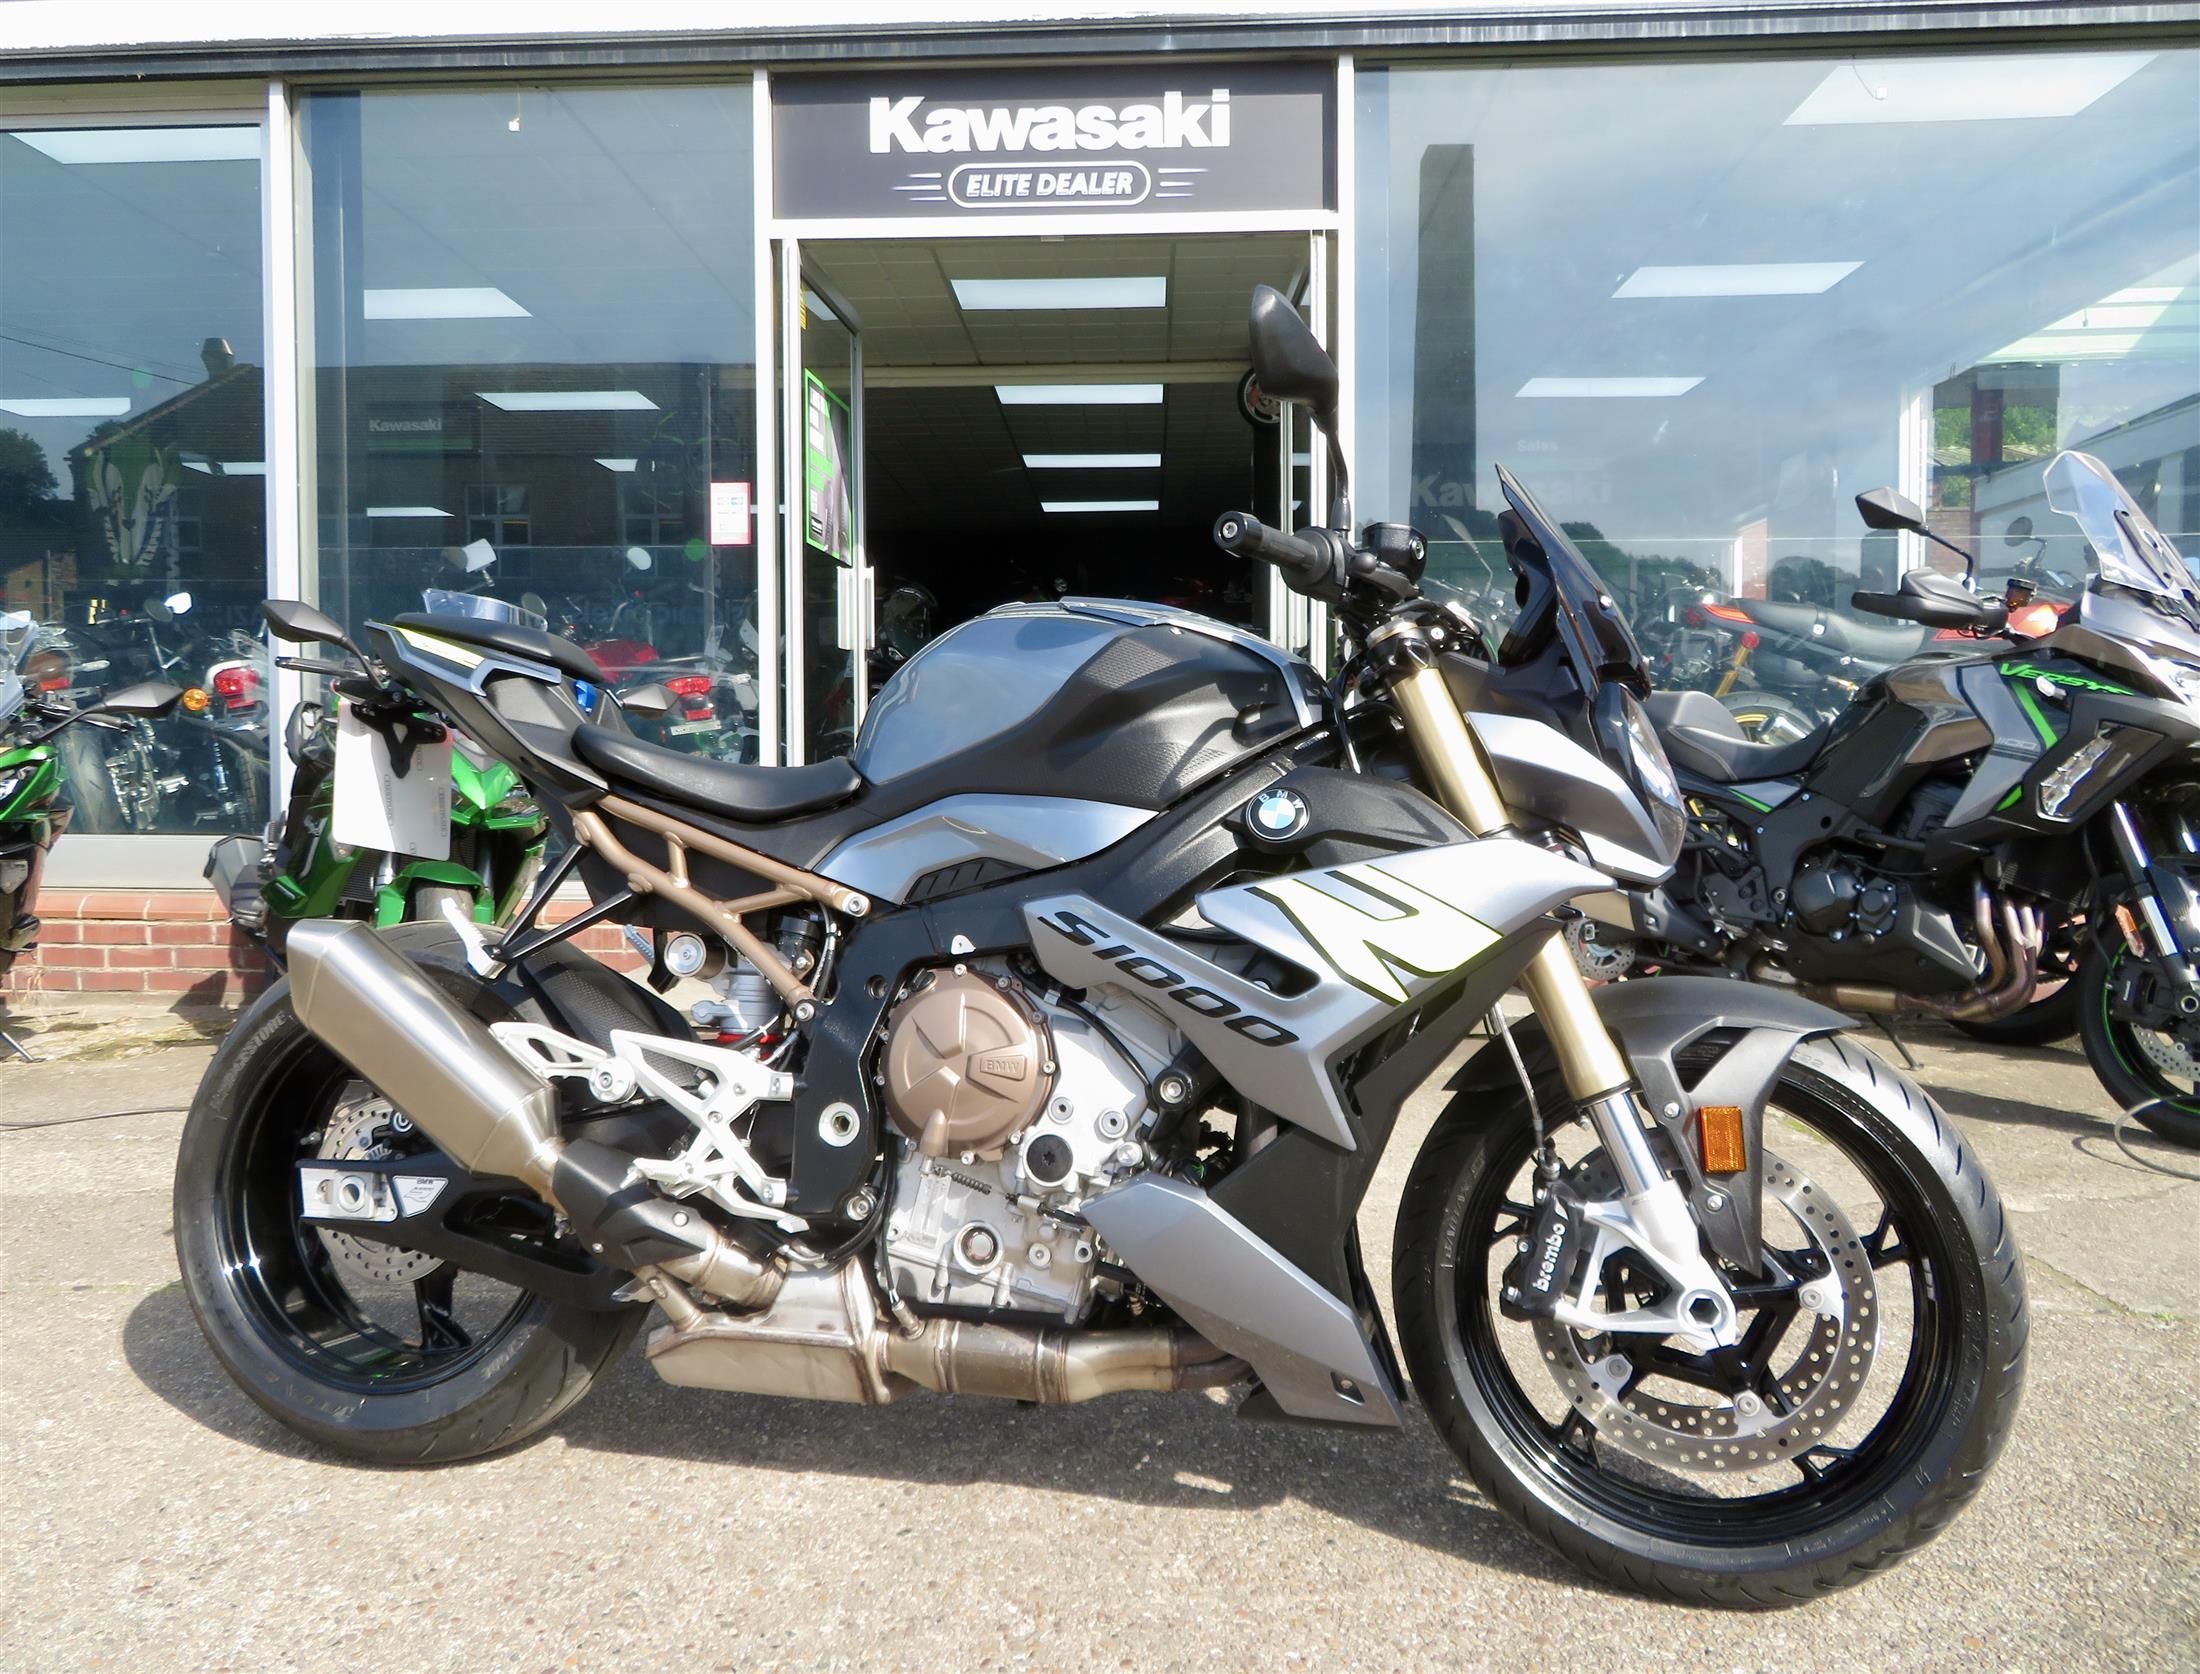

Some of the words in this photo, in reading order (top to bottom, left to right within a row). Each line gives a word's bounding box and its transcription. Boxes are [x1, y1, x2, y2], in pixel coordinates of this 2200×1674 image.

[869, 88, 1230, 153] Kawasaki
[966, 174, 1032, 197] ELITE
[1036, 172, 1134, 196] DEALER
[368, 418, 442, 432] Kawasaki
[1516, 439, 1559, 452] Sales
[1411, 472, 1613, 507] Kawsaki
[1258, 789, 1305, 809] BMW
[1037, 911, 1300, 1047] S1000
[985, 1059, 1019, 1073] BMW
[1532, 1223, 1566, 1292] brembo
